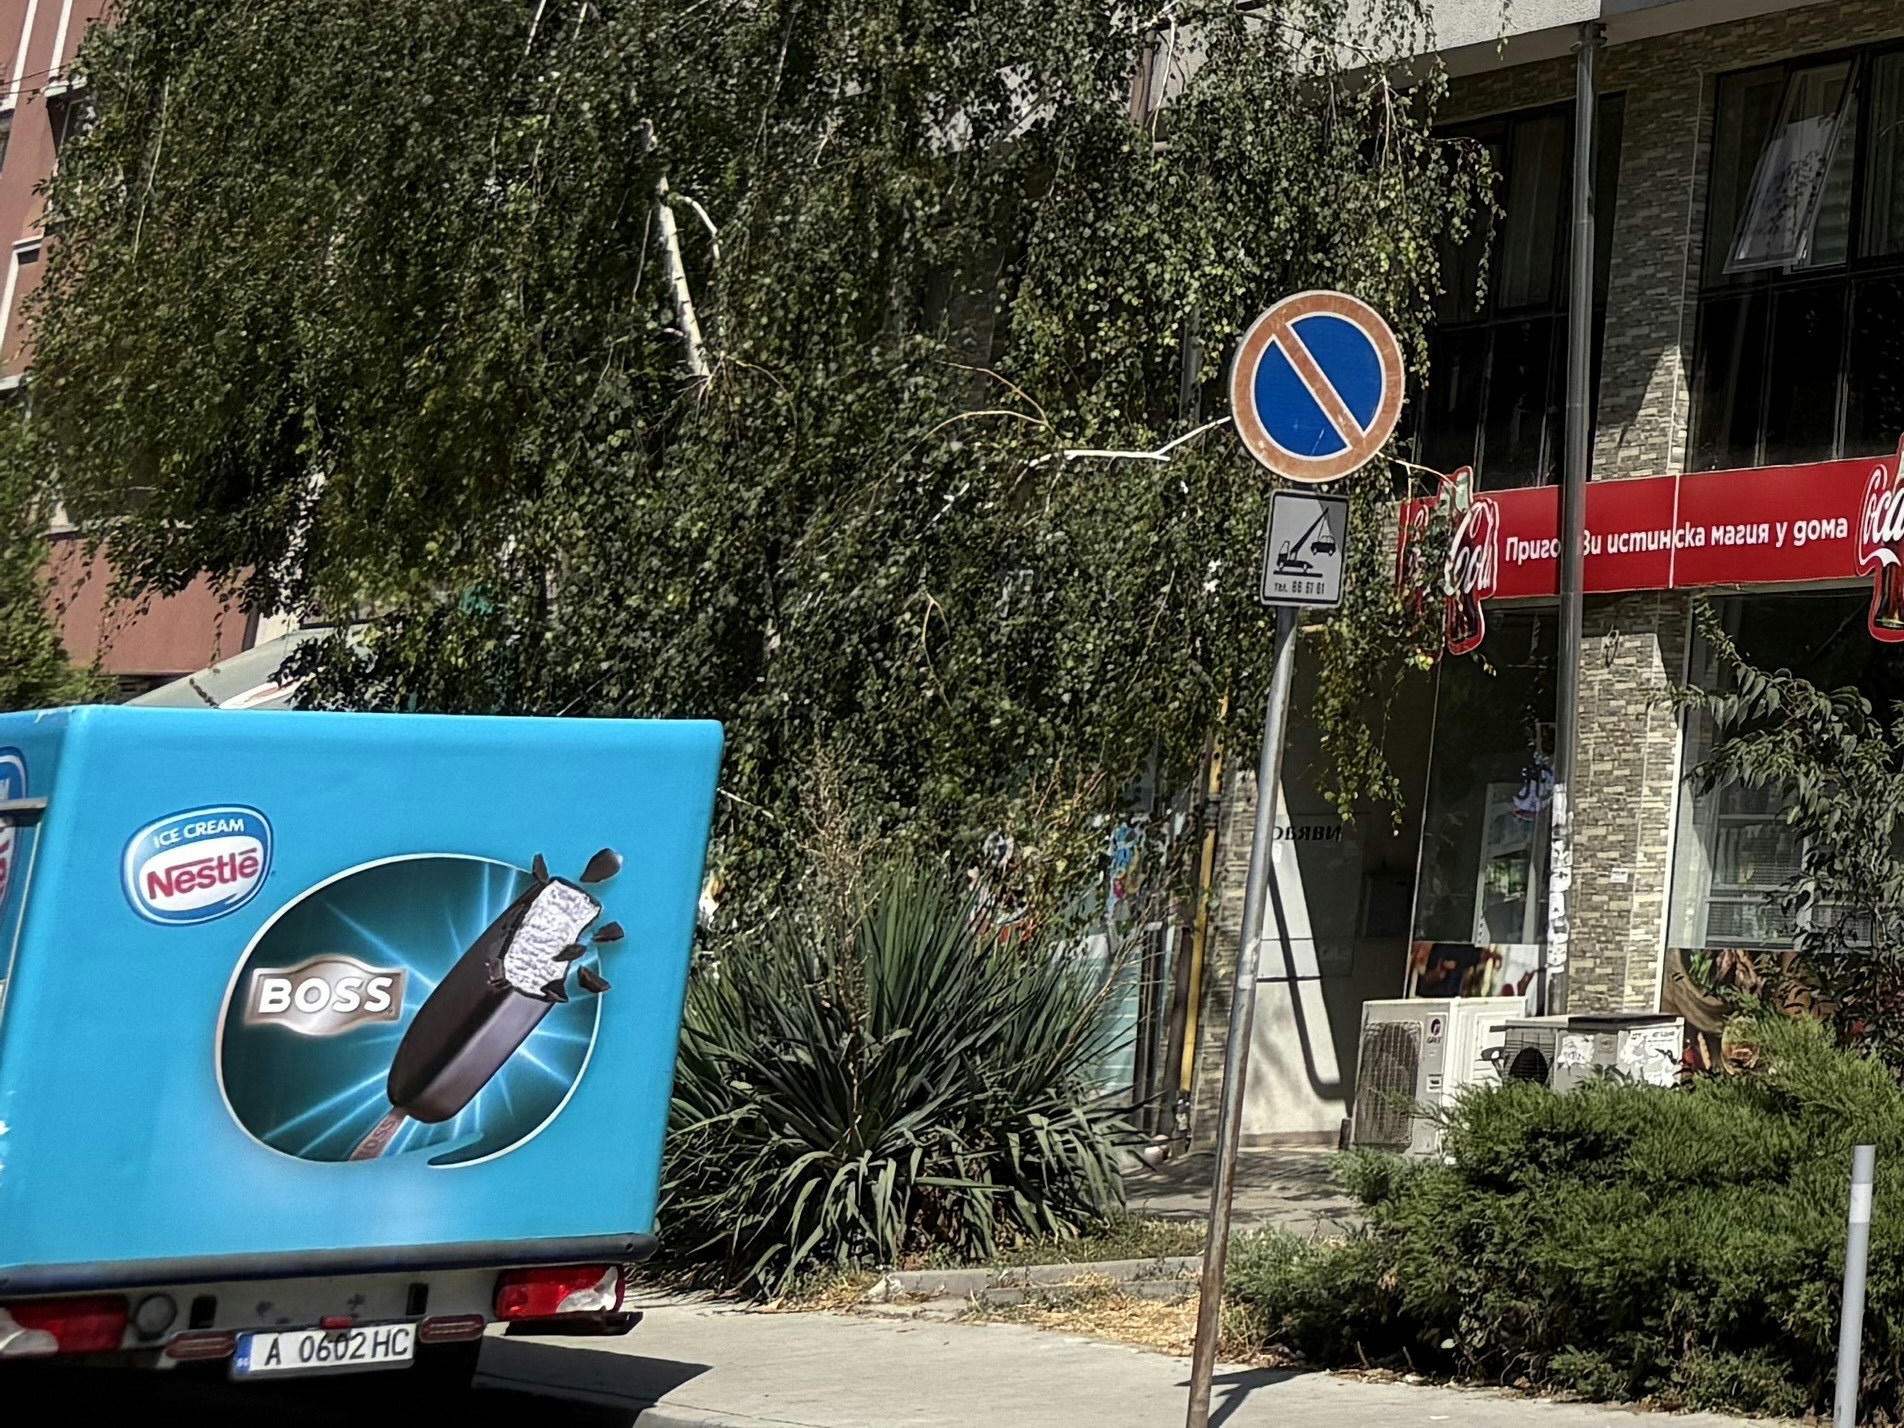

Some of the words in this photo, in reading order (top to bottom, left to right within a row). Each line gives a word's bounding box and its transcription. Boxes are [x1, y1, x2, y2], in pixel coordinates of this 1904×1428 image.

[1505, 528, 1601, 565] Пригови
[1607, 522, 1705, 555] истинска
[1711, 522, 1769, 547] магия
[1775, 521, 1788, 547] у
[1793, 517, 1848, 548] дома
[154, 828, 181, 848] ICE
[184, 818, 245, 838] CREAM
[258, 977, 393, 1013] BOSS
[264, 1337, 281, 1366] A
